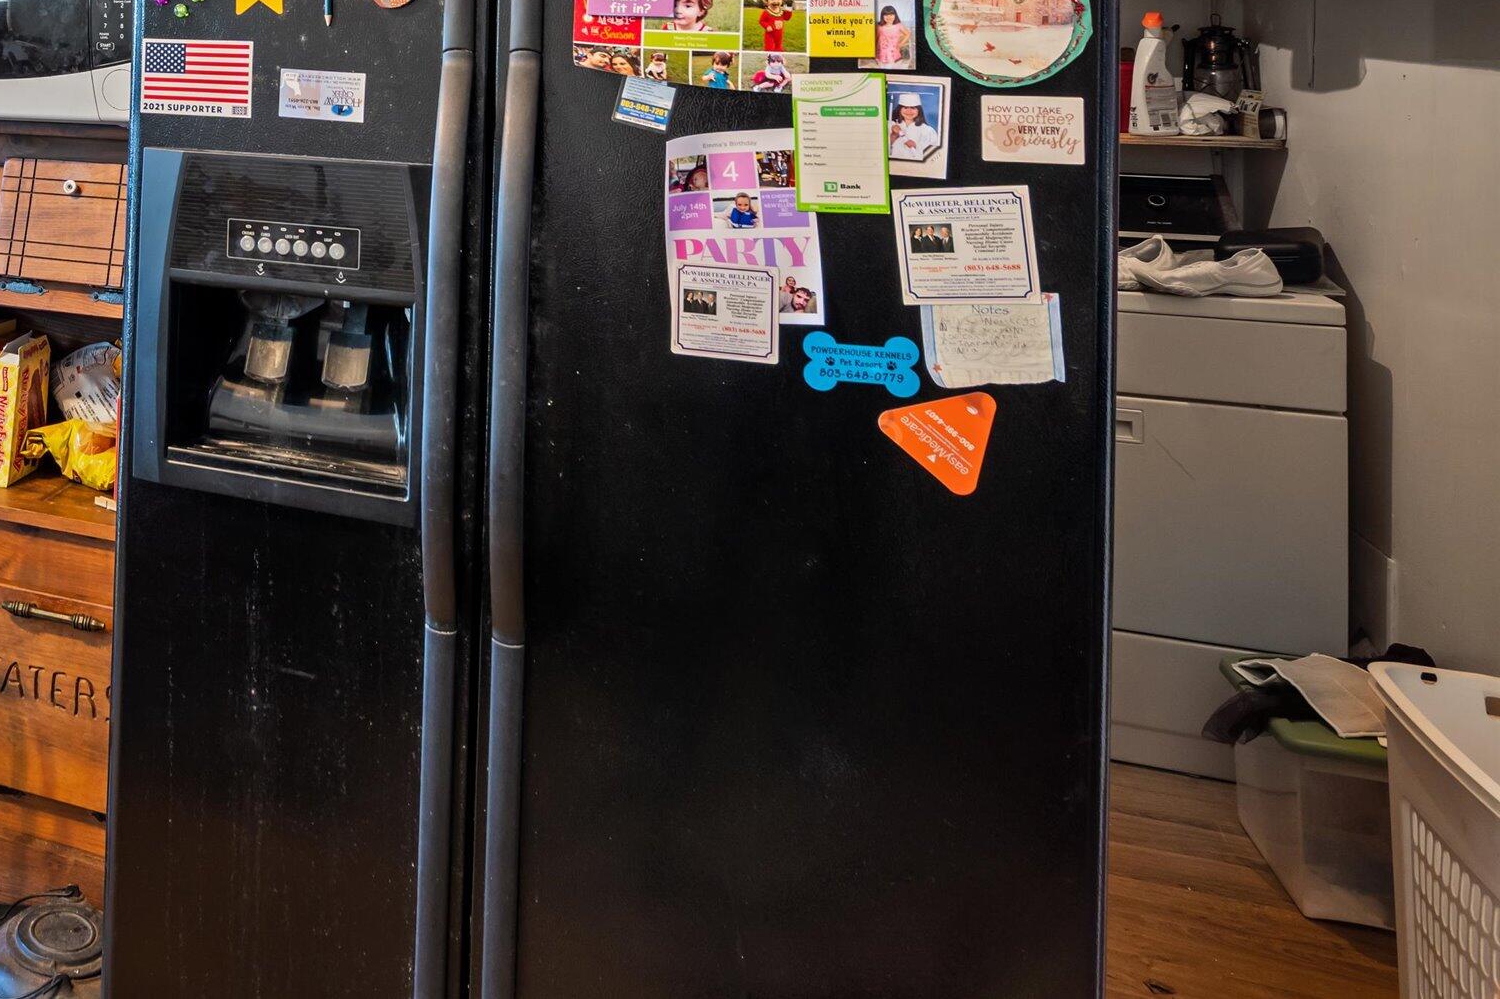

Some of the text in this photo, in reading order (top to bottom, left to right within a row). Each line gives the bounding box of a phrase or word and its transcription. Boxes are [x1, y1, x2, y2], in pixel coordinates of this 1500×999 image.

[610, 2, 652, 14] fit in?
[809, 0, 836, 8] STUPID
[809, 15, 875, 27] Looks like you're
[826, 28, 856, 39] winning
[833, 40, 849, 48] too.
[143, 102, 223, 114] 2021 SUPPORTER
[987, 105, 1012, 113] HOW
[1014, 106, 1030, 114] DO
[1038, 106, 1062, 115] TAKE
[987, 112, 1075, 126] my coffee?
[1018, 125, 1061, 135] VERY, VERY
[729, 140, 757, 148] Birthday
[1003, 127, 1081, 154] Seriously
[722, 160, 740, 183] 4
[672, 202, 708, 212] July 14th
[964, 198, 1019, 207] BELLINGER
[681, 211, 699, 220] 2pm
[673, 237, 811, 268] PARTY
[964, 264, 984, 272] (803)
[985, 263, 1022, 271] 648-5688
[728, 272, 770, 283] BELLINGER
[971, 304, 1010, 315] Notes
[810, 346, 912, 361] POWDERHOUSE KENNELS
[839, 358, 883, 369] Pet Resort
[819, 368, 905, 383] 803-648-0779
[900, 415, 969, 475] easyMedicare
